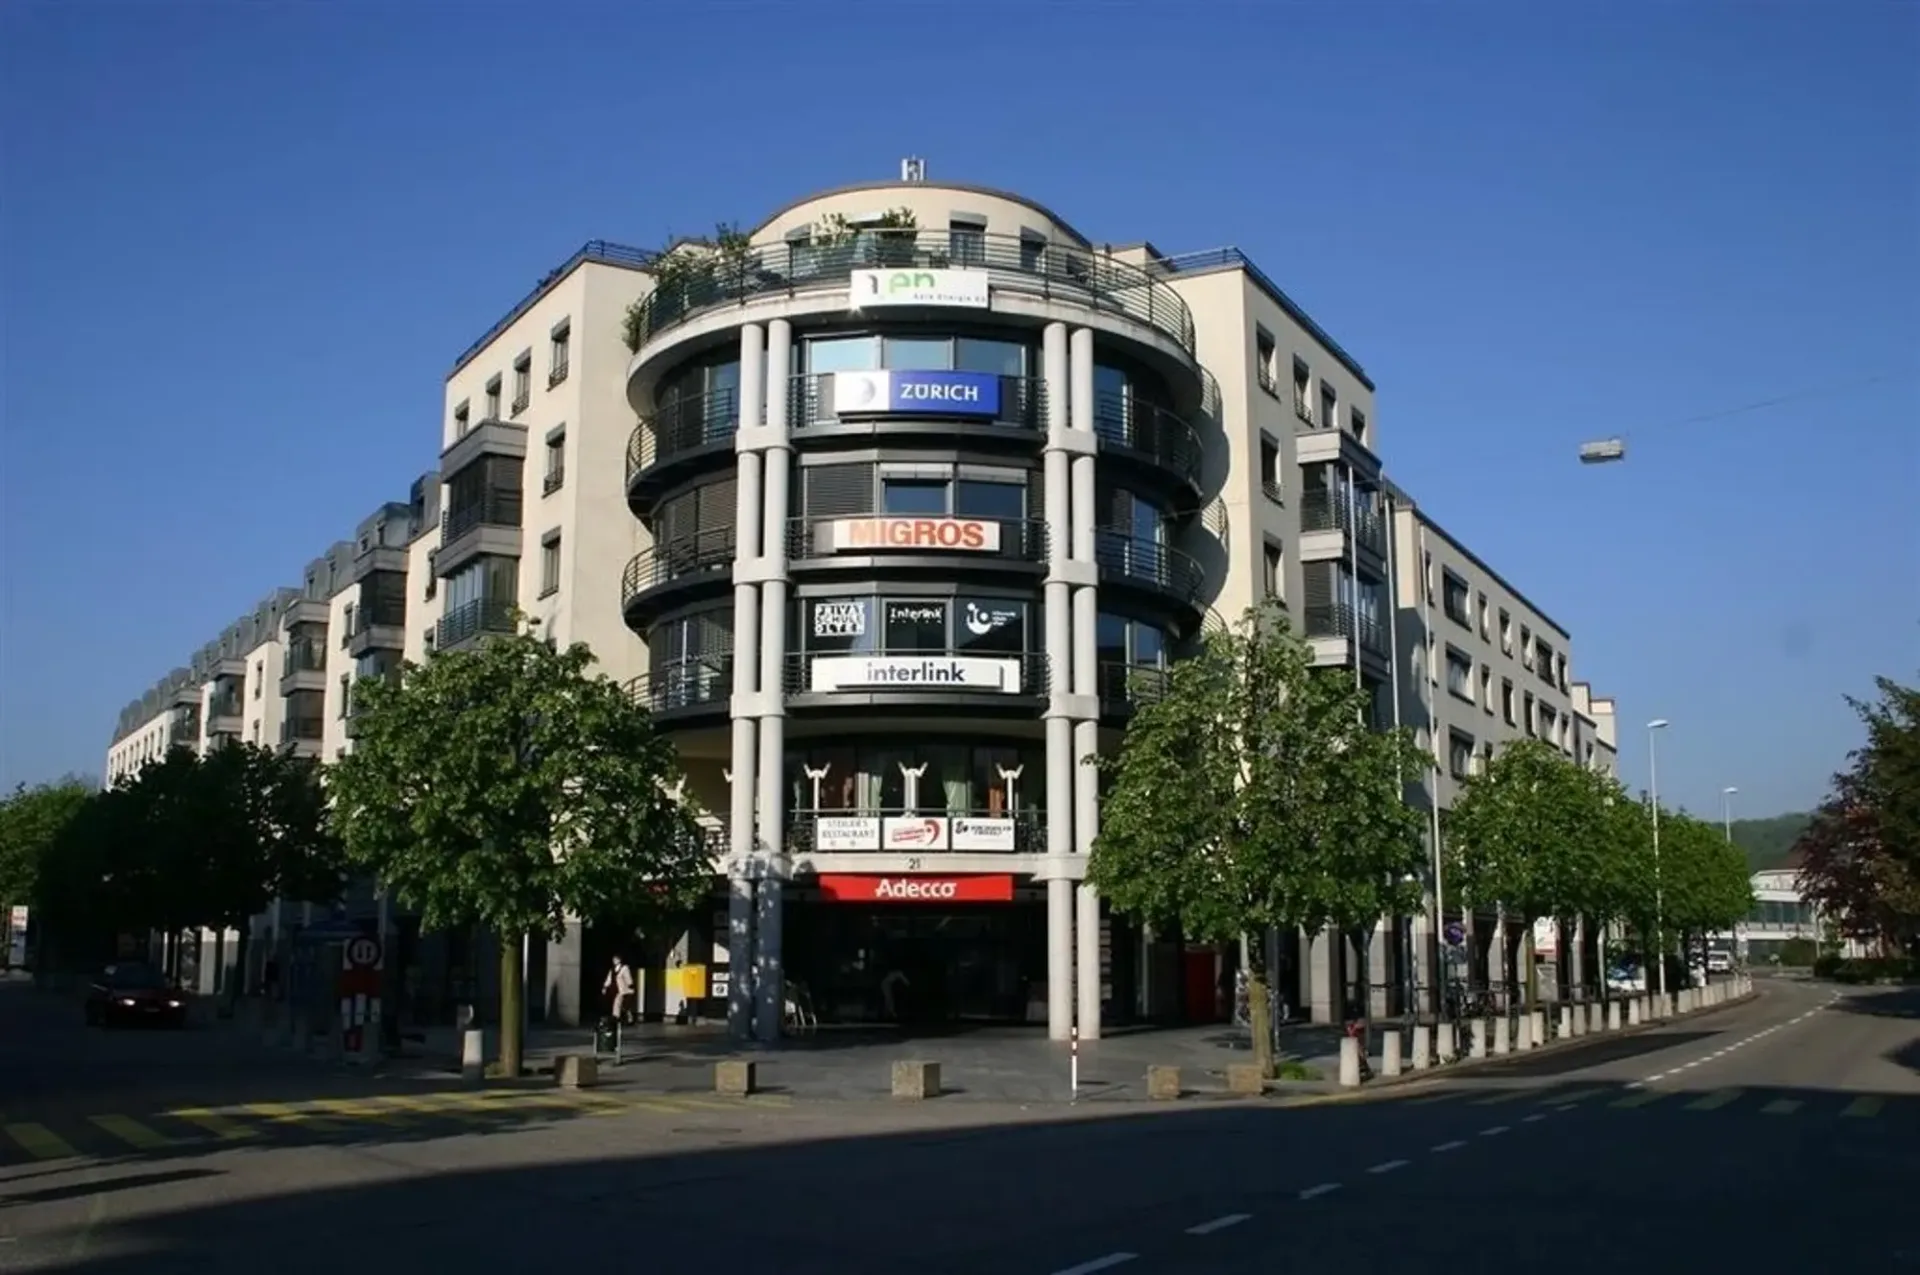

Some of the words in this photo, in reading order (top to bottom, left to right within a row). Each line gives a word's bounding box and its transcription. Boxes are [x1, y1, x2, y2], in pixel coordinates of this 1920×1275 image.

[850, 520, 985, 547] MIGROS
[867, 661, 965, 682] interlink
[909, 858, 921, 870] 21
[875, 879, 957, 898] Adecco
